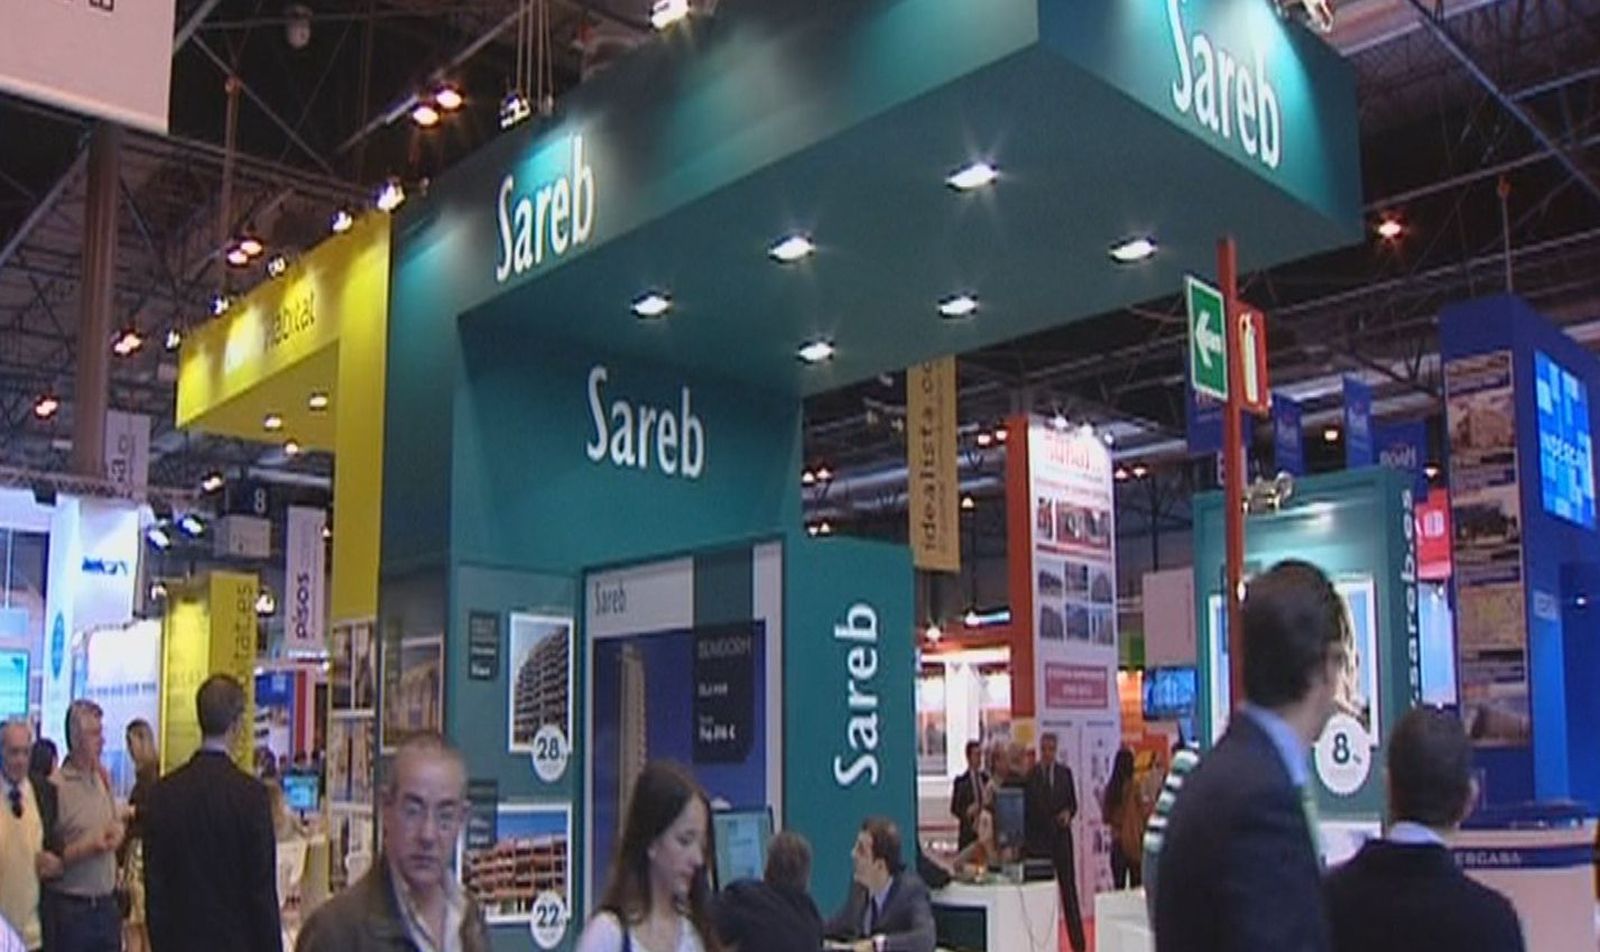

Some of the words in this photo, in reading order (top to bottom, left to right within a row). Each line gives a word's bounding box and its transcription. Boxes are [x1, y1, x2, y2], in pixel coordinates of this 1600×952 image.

[1168, 0, 1280, 169] Sareb
[496, 133, 595, 282] Sareb
[586, 364, 705, 479] Sareb
[254, 487, 267, 514] 8
[292, 573, 310, 639] pisos
[594, 579, 628, 616] Sareb
[834, 603, 878, 786] Sareb
